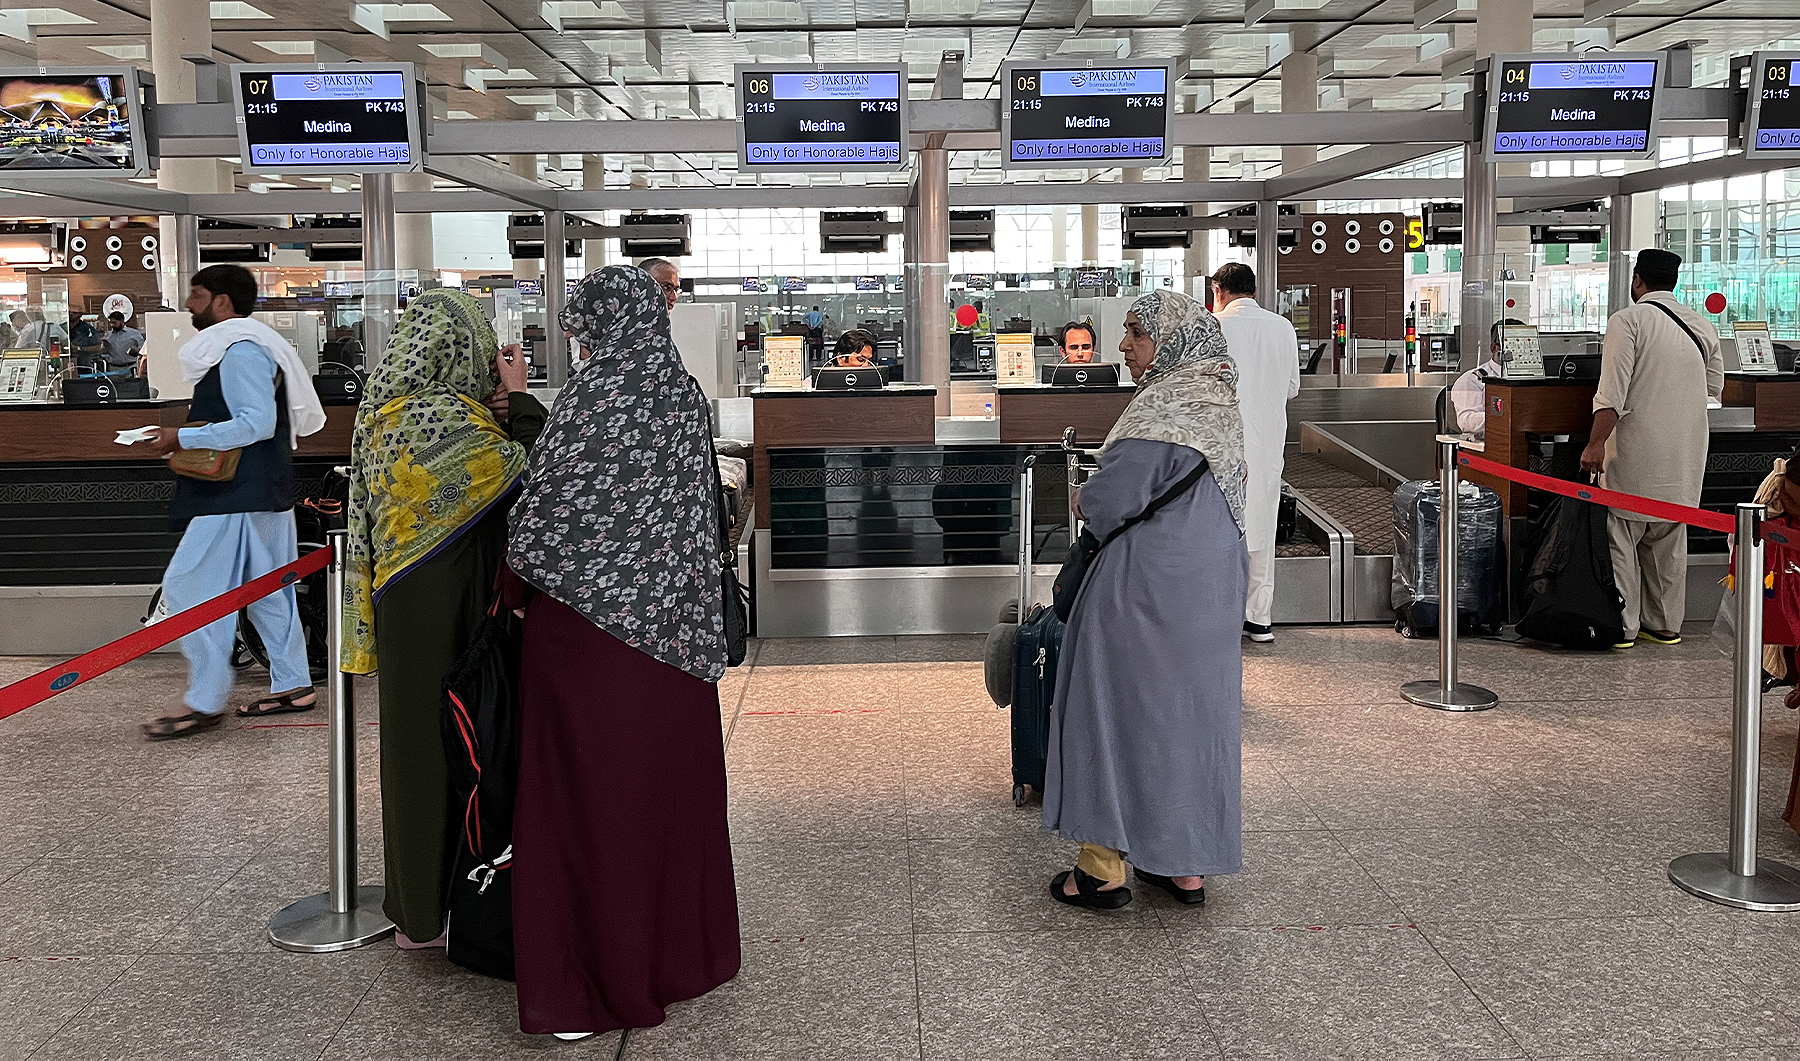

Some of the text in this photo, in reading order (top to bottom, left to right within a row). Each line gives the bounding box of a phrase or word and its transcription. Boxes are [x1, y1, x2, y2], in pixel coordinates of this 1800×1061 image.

[1579, 64, 1626, 74] PAKISTAN
[1768, 66, 1786, 81] 03
[323, 75, 373, 86] PAKISTAN
[821, 75, 869, 85] PAKISTAN
[1089, 71, 1137, 81] PAKISTAN
[1506, 69, 1525, 83] 04
[249, 80, 268, 95] 07
[749, 79, 769, 94] 06
[1017, 76, 1036, 91] 05
[1500, 91, 1530, 102] 21:15
[1613, 90, 1651, 101] PK 743
[1762, 89, 1790, 99] 21:15
[247, 103, 278, 114] 21:15
[365, 101, 404, 113] PK 743
[746, 102, 775, 113] 21:15
[860, 101, 898, 112] PK 743
[1013, 99, 1042, 110] 21:15
[1126, 97, 1164, 108] PK 743
[1550, 108, 1596, 121] Medina
[303, 120, 352, 133] Medina
[799, 119, 846, 132] Medina
[1065, 116, 1111, 128] Medina
[1500, 134, 1645, 149] Only for Honorable Hajis
[1760, 132, 1800, 146] Only fo
[257, 147, 409, 161] Only for Honorable Hajis
[752, 146, 899, 160] Only for Honorable Hajis
[1016, 142, 1162, 157] Only for Honorable Hajis
[1408, 221, 1423, 248] 5
